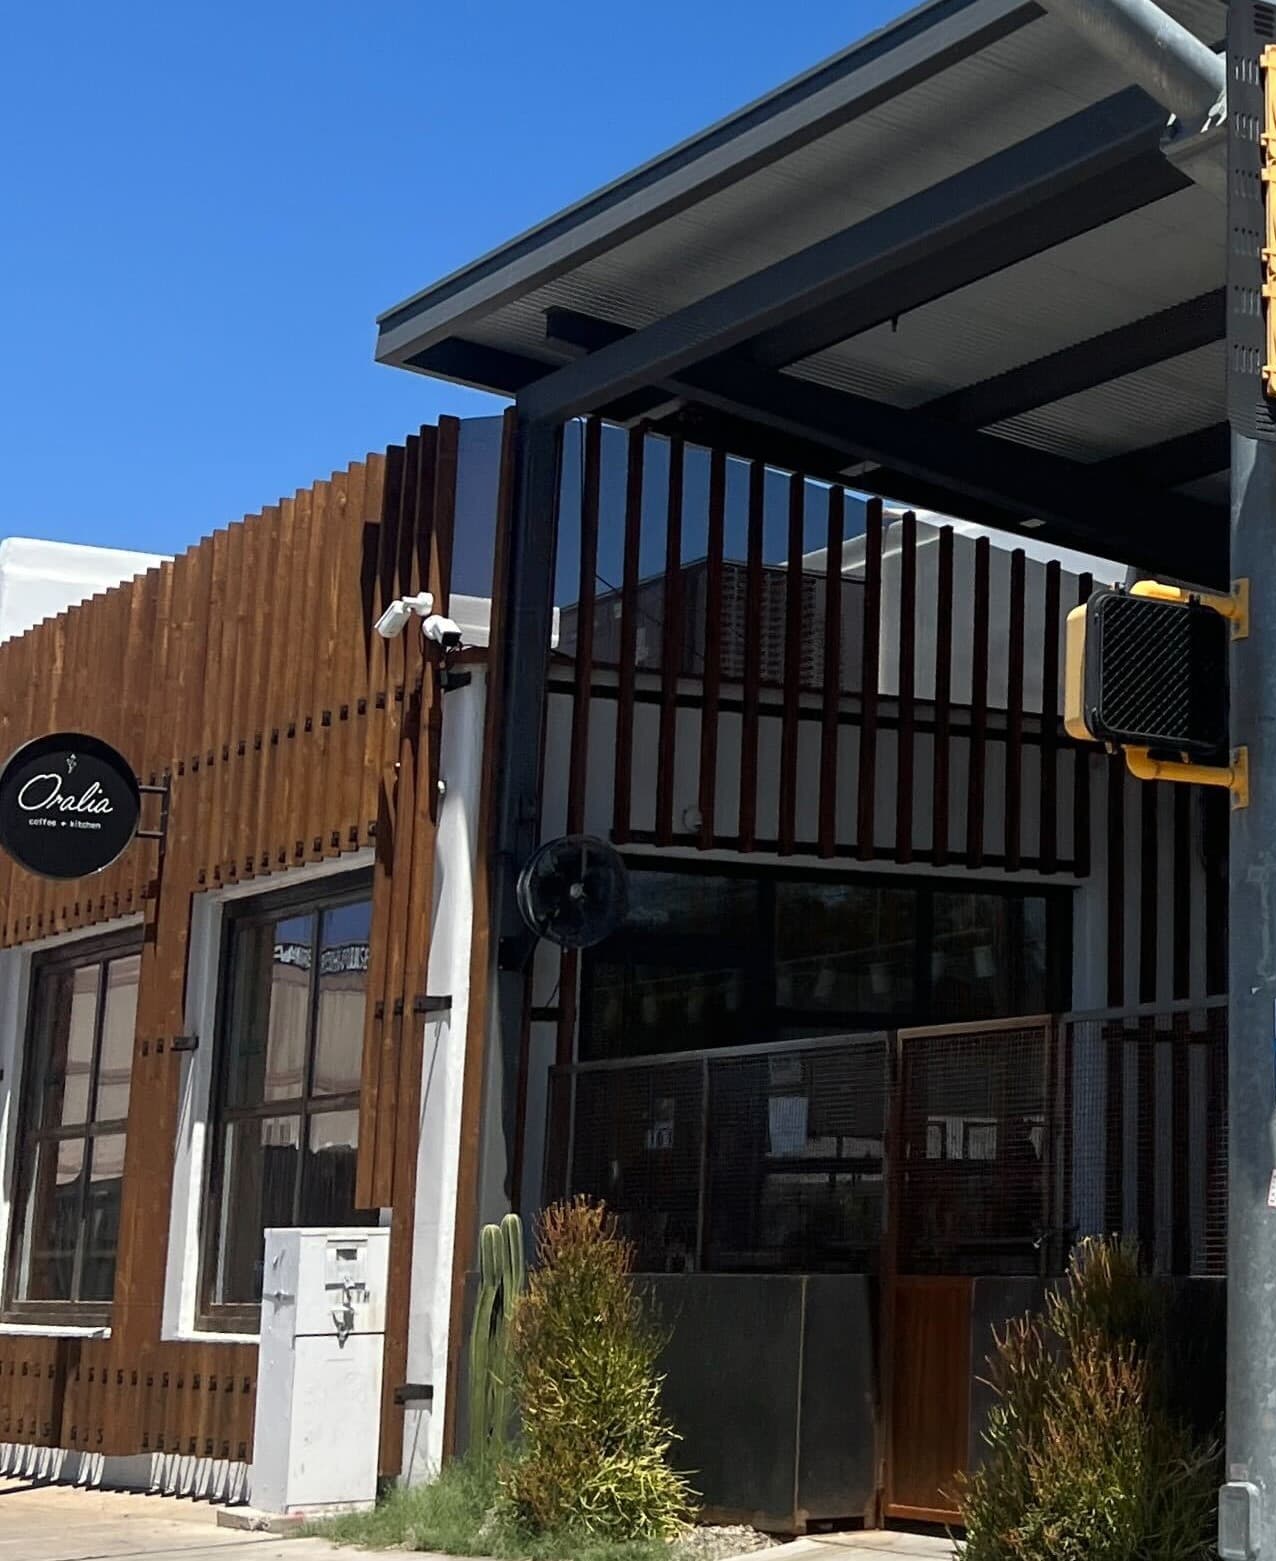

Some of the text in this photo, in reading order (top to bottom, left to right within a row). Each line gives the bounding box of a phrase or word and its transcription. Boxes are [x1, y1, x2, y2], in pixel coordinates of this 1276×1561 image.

[18, 773, 113, 813] Oralia
[28, 818, 57, 827] coffee
[69, 820, 102, 829] kitchen
